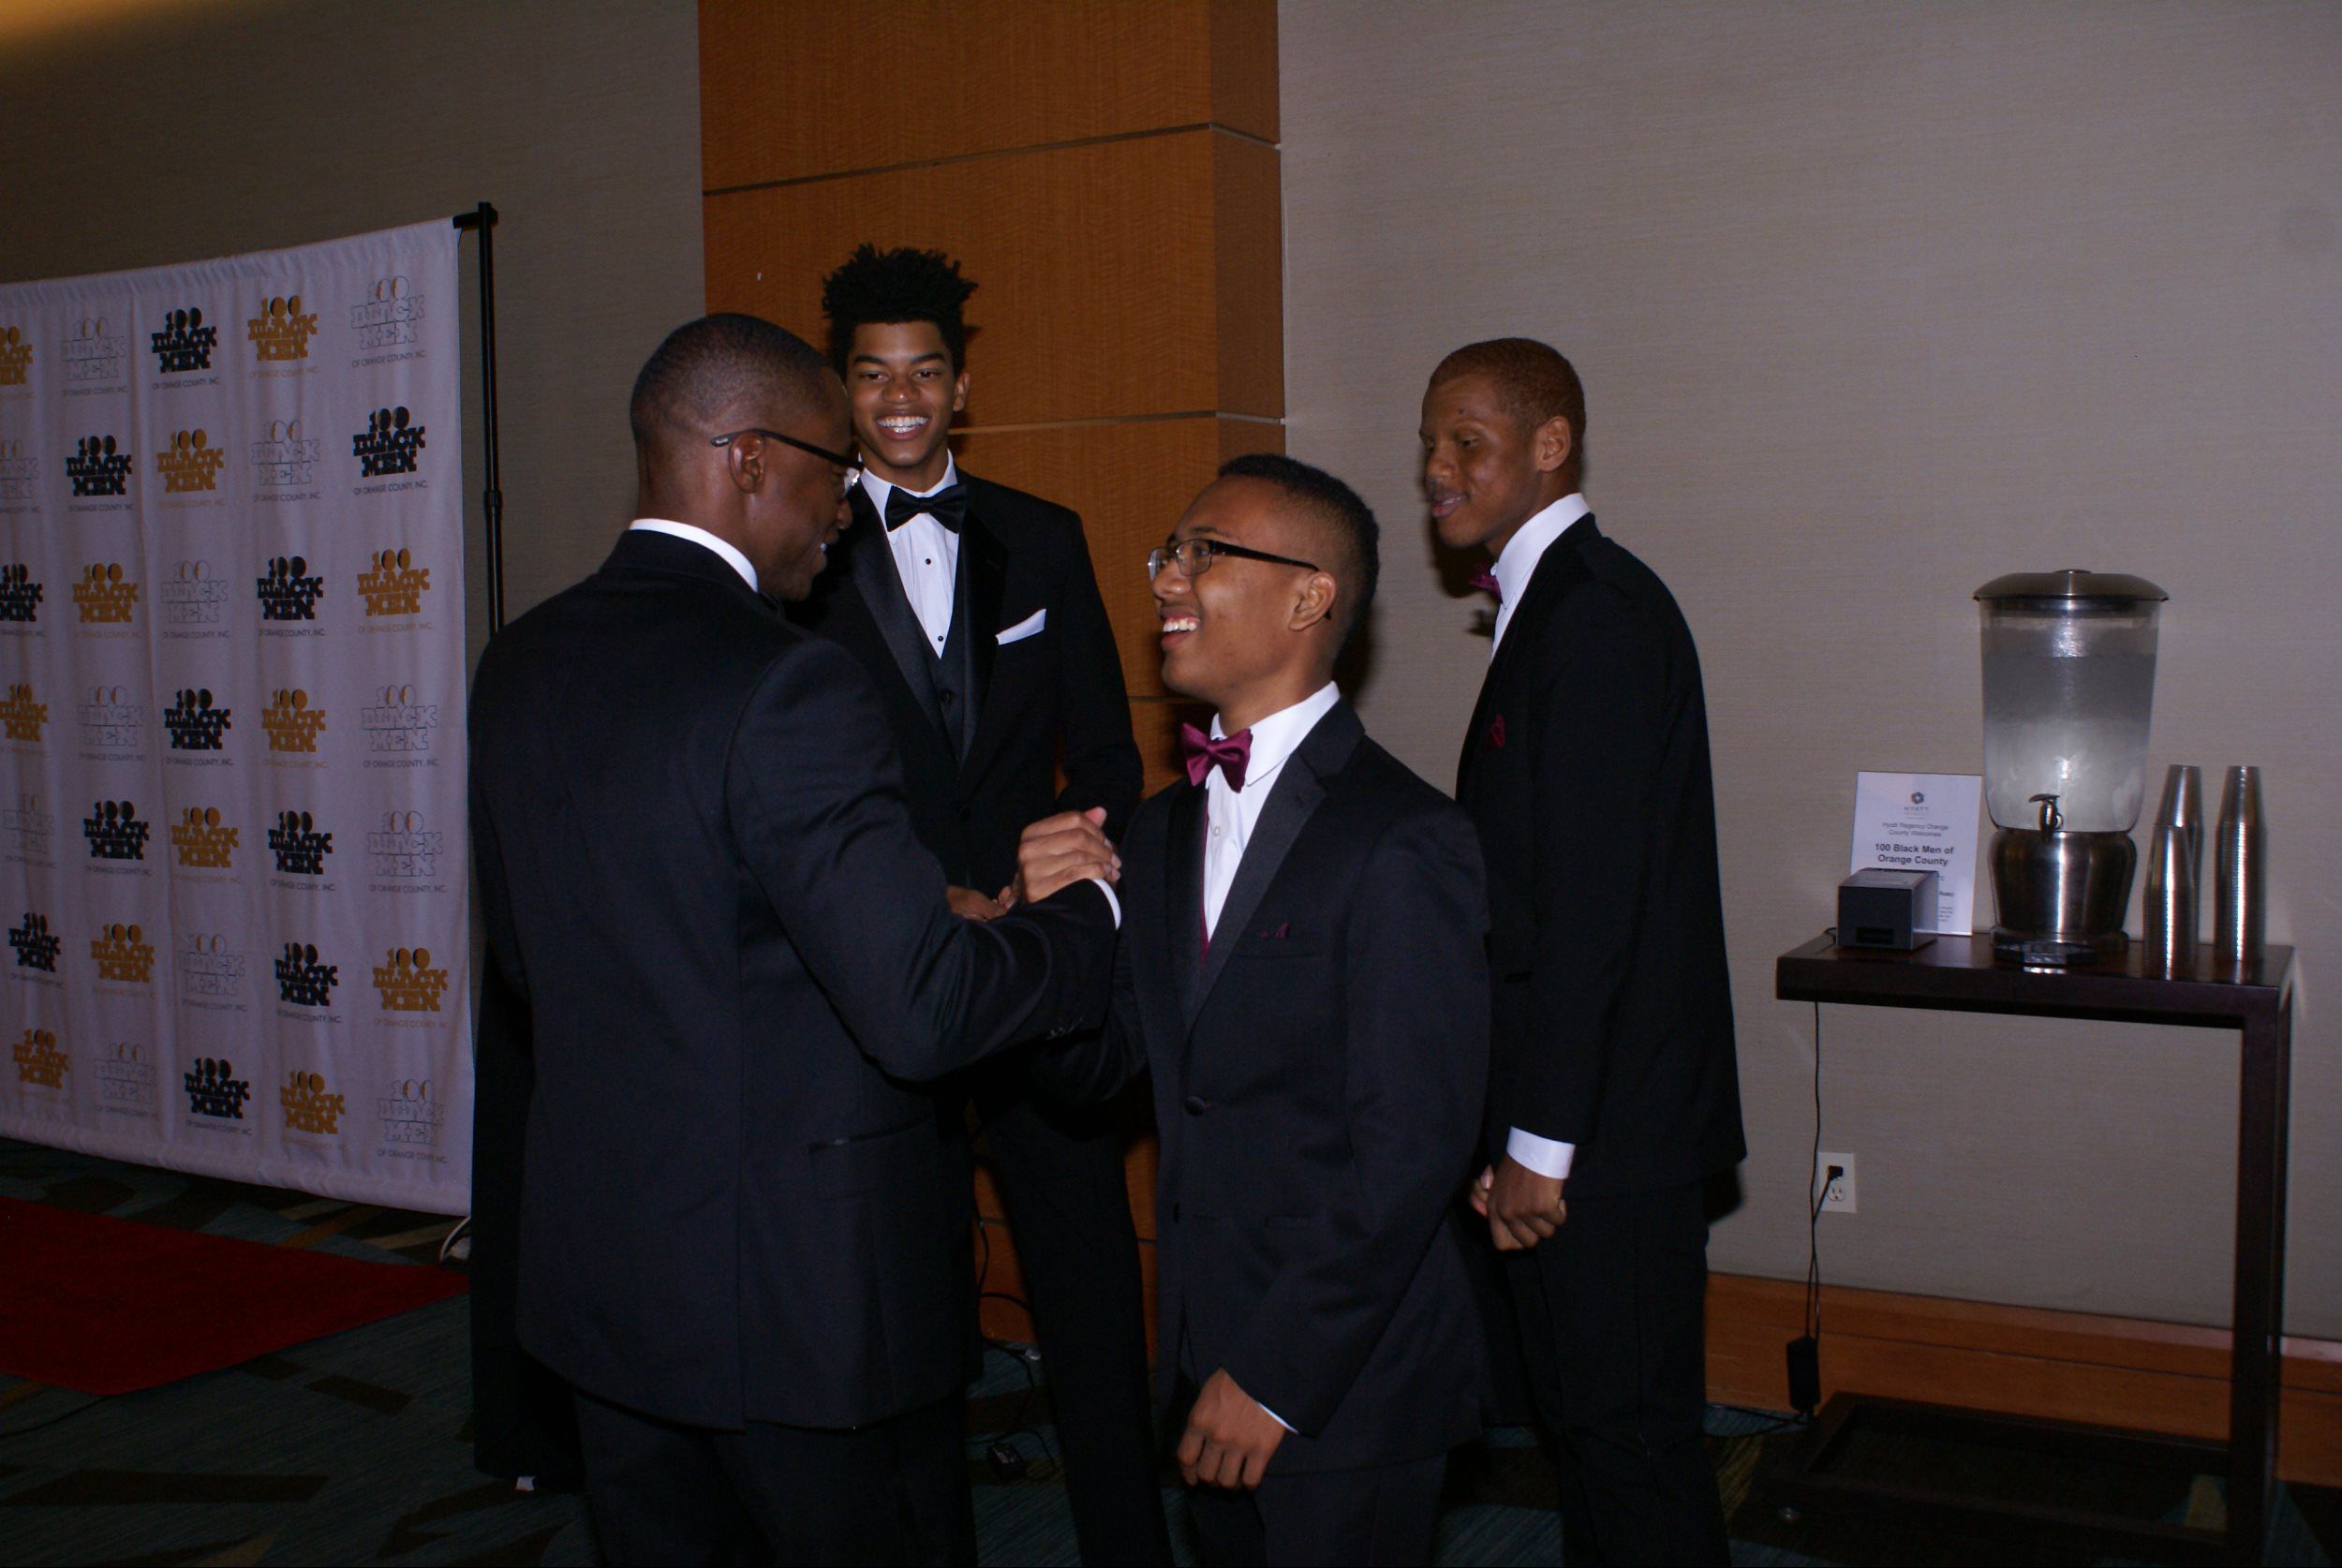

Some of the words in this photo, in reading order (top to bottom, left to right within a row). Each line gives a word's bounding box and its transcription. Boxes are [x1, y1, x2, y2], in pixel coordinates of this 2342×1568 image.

[262, 295, 300, 318] 100
[166, 307, 202, 331] 100
[248, 314, 318, 341] BLACK
[152, 326, 217, 353] BLACK
[257, 337, 308, 362] MEN
[159, 348, 210, 374] MEN
[369, 407, 409, 432] 100
[79, 435, 116, 457] 100
[170, 428, 207, 451] 100
[353, 426, 425, 456] BLACK
[67, 454, 133, 477] BLACK
[156, 448, 224, 473] BLACK
[362, 450, 417, 477] MEN
[73, 474, 126, 496] MEN
[165, 469, 216, 493] MEN
[363, 485, 387, 495] ORANGE
[268, 555, 306, 579] 100
[372, 547, 411, 572] 100
[2, 563, 28, 583] 100
[83, 563, 123, 584] 100
[357, 569, 430, 596] BLACK
[72, 583, 139, 603] BLACK
[257, 576, 323, 599] BLACK
[80, 600, 132, 623] MEN
[263, 599, 315, 620] MEN
[365, 591, 421, 616] MEN
[9, 684, 32, 704] 100
[176, 688, 213, 710] 100
[273, 688, 307, 711] 100
[164, 708, 231, 730] BLACK
[262, 708, 326, 731] BLACK
[5, 720, 40, 742] MEN
[171, 729, 223, 749] MEN
[268, 730, 317, 752] MEN
[373, 760, 395, 768] ORANGE
[94, 800, 135, 821] 100
[183, 806, 220, 826] 100
[278, 810, 313, 833] 100
[83, 818, 150, 841] BLACK
[171, 824, 239, 848] BLACK
[268, 828, 333, 853] BLACK
[91, 838, 144, 860] MEN
[178, 845, 231, 868] MEN
[1875, 843, 1890, 851] 100
[1892, 844, 1919, 852] Black
[1921, 845, 1941, 853] Men
[275, 851, 323, 875] MEN
[1877, 854, 1912, 865] Orange
[1914, 855, 1949, 866] County
[23, 912, 47, 935] 100
[103, 924, 142, 944] 100
[8, 928, 60, 954] BLACK
[91, 940, 155, 965] BLACK
[18, 947, 56, 972] MEN
[285, 942, 318, 965] 100
[387, 947, 430, 969] 100
[98, 959, 150, 984] MEN
[274, 958, 338, 986] BLACK
[373, 967, 448, 990] BLACK
[281, 981, 330, 1006] MEN
[380, 989, 440, 1012] MEN
[24, 1028, 56, 1050] 100
[13, 1043, 69, 1072] BLACK
[19, 1064, 63, 1089] MEN
[195, 1058, 232, 1082] 100
[185, 1072, 250, 1101] BLACK
[289, 1071, 325, 1093] 100
[191, 1094, 244, 1119] MEN
[280, 1084, 345, 1115] BLACK
[285, 1108, 338, 1134] MEN
